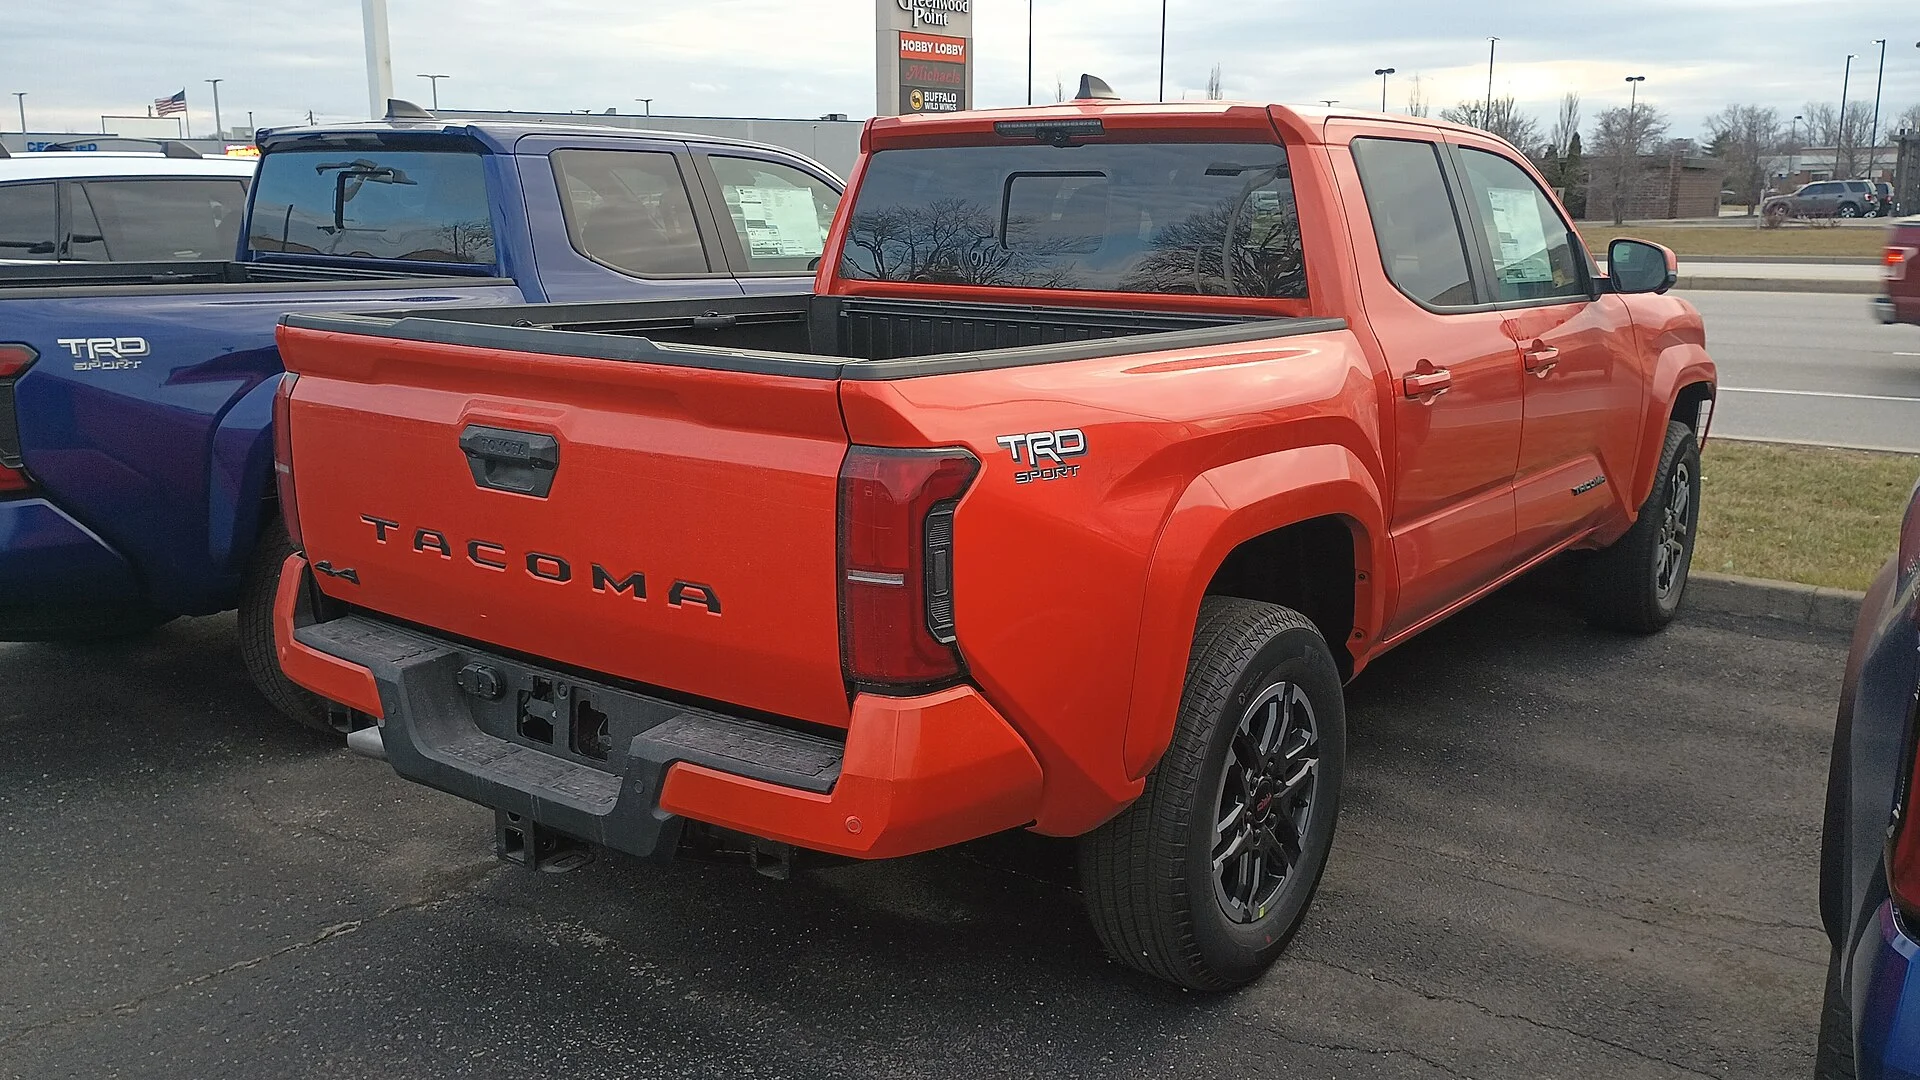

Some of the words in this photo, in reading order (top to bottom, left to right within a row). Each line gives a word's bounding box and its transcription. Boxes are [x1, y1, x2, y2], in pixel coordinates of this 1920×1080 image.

[913, 7, 948, 28] Point
[901, 40, 933, 53] HOBBY
[935, 43, 964, 56] LOBBY
[905, 64, 961, 83] Michaels
[924, 91, 957, 103] BUFFALO
[924, 102, 938, 110] WILD
[939, 103, 957, 111] WINGS
[27, 142, 98, 152] CEIED
[57, 337, 149, 361] TRD
[73, 360, 142, 371] SPORT
[996, 428, 1088, 467] TRD
[1015, 464, 1081, 484] SPORT
[1570, 474, 1606, 496] TACOMA
[359, 513, 722, 617] TACOMA
